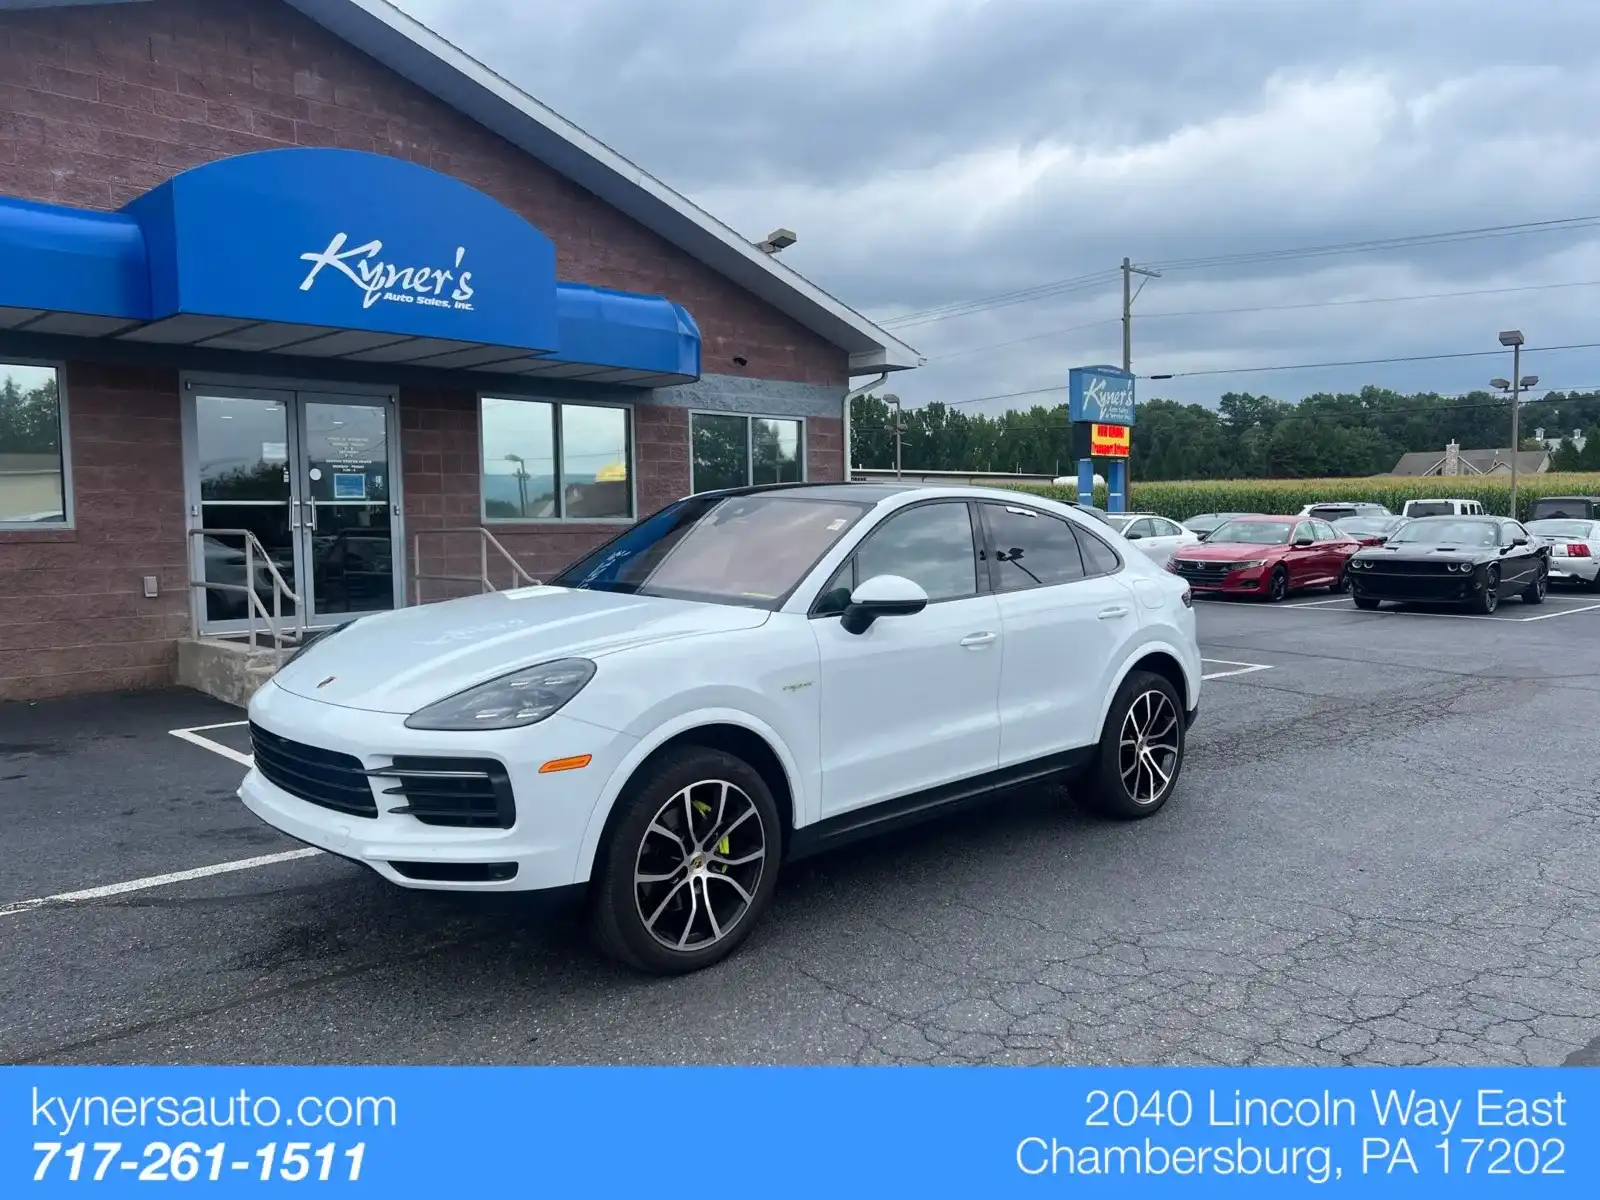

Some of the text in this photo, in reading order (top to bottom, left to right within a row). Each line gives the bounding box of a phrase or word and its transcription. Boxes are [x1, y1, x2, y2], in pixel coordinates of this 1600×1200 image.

[299, 232, 475, 309] Kyner's
[383, 292, 414, 303] Auto
[416, 296, 451, 309] Sales,
[1083, 377, 1133, 421] Kyner's
